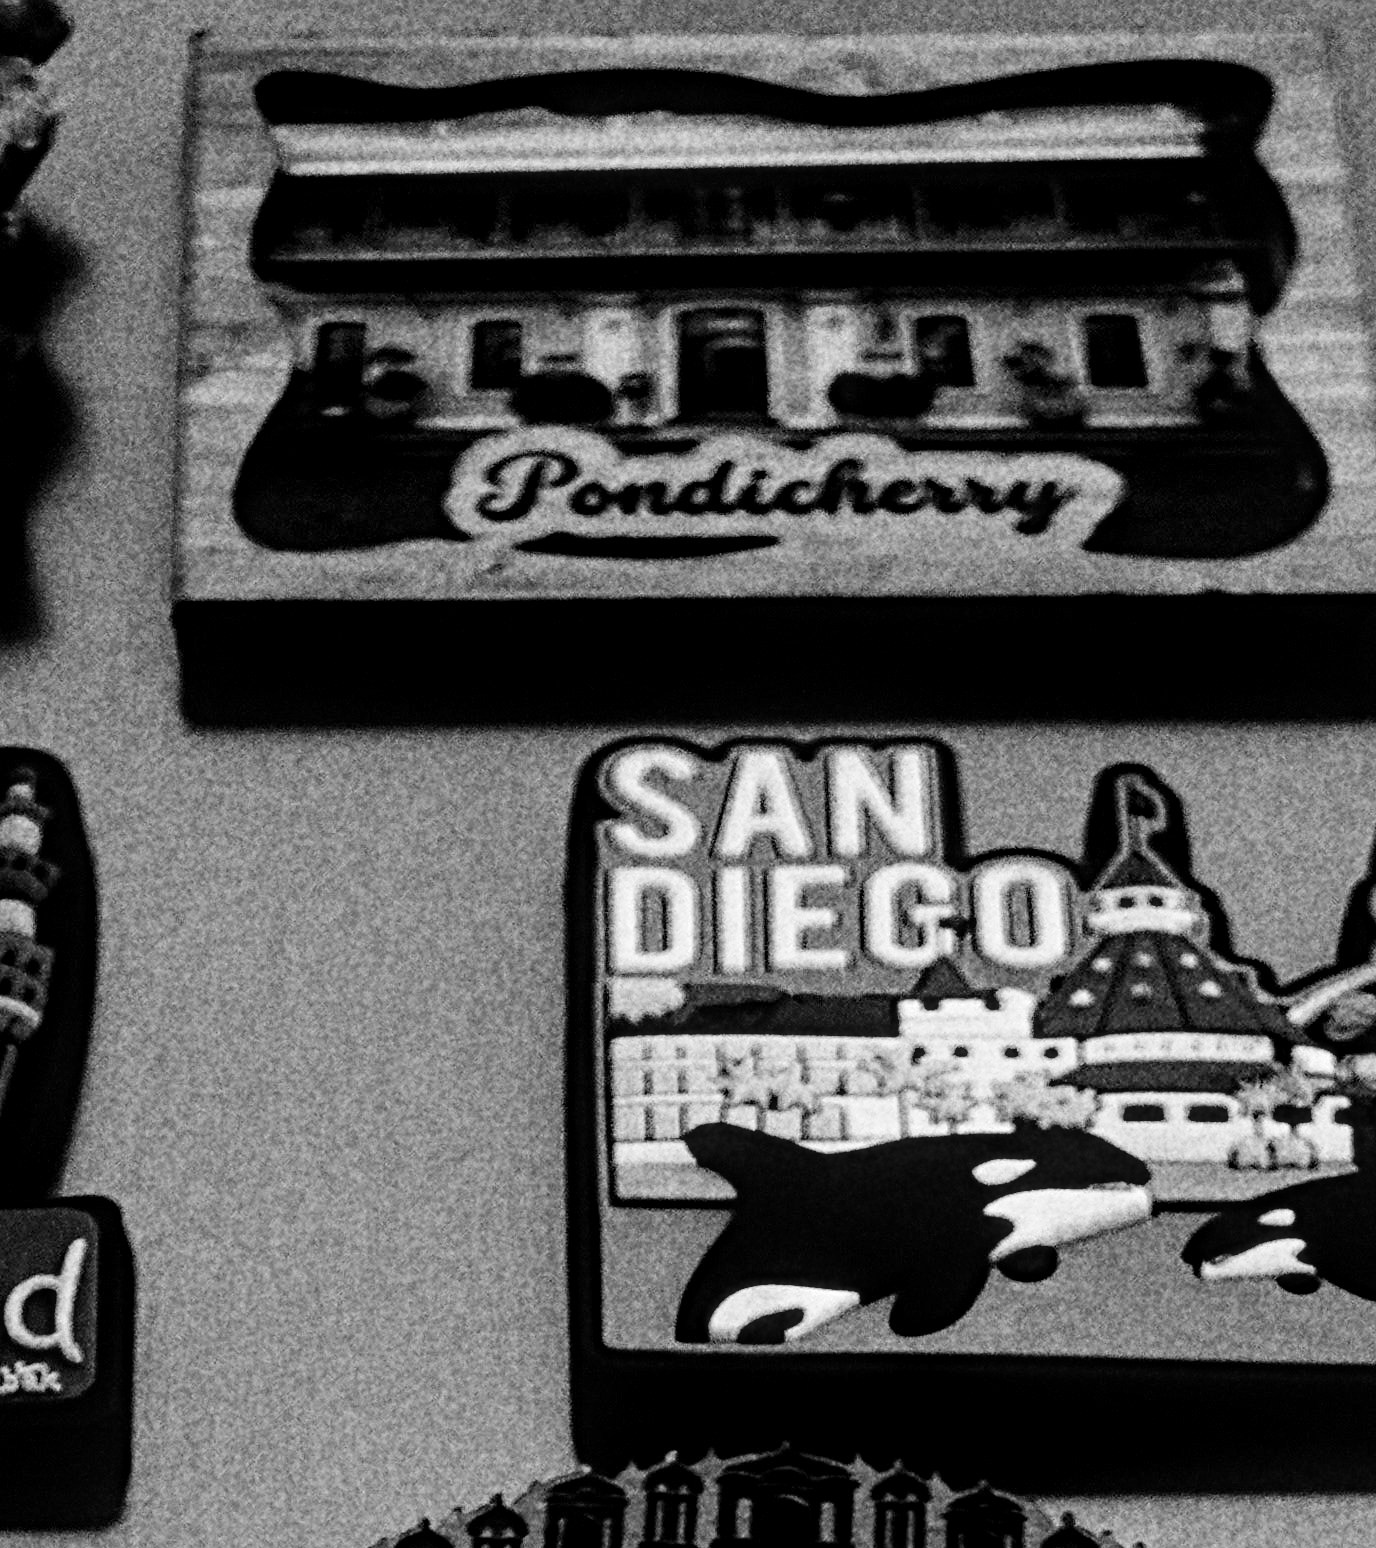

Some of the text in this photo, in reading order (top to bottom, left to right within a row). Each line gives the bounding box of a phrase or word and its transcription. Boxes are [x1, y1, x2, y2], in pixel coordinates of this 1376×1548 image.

[477, 450, 1080, 536] Pondicherry
[610, 745, 934, 860] SAN
[608, 861, 1072, 973] DIEGO
